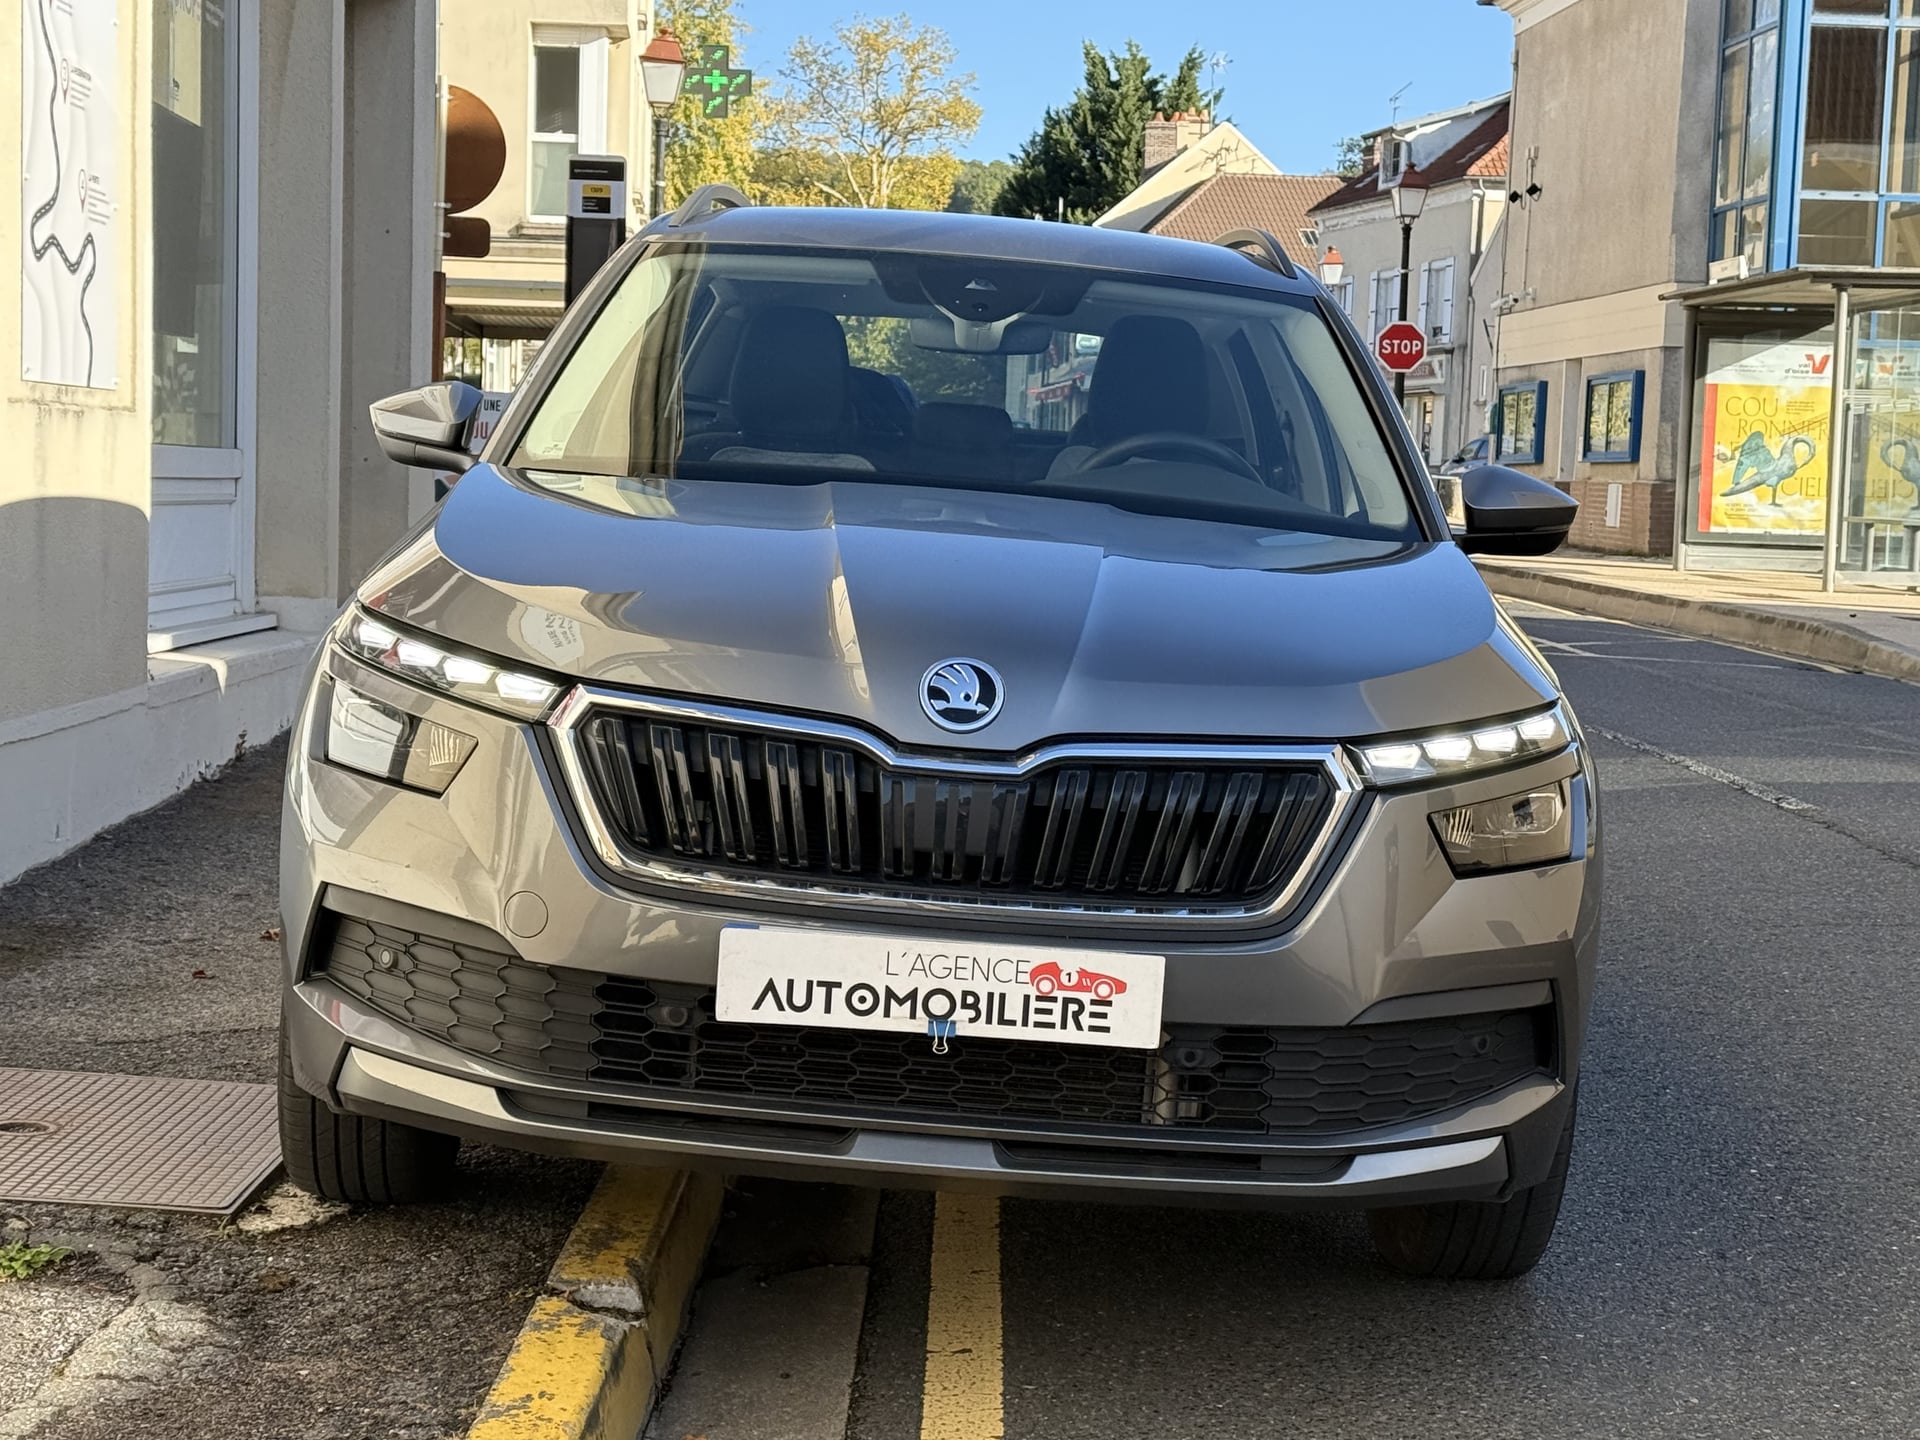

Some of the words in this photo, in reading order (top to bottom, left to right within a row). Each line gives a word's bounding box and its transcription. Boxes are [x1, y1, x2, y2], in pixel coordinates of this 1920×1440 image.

[1381, 339, 1422, 355] STOP
[483, 400, 501, 412] UNE
[1725, 396, 1779, 417] COU
[1781, 476, 1827, 497] CIEL
[886, 951, 1031, 985] L'AGENCE
[1064, 971, 1073, 984] 1
